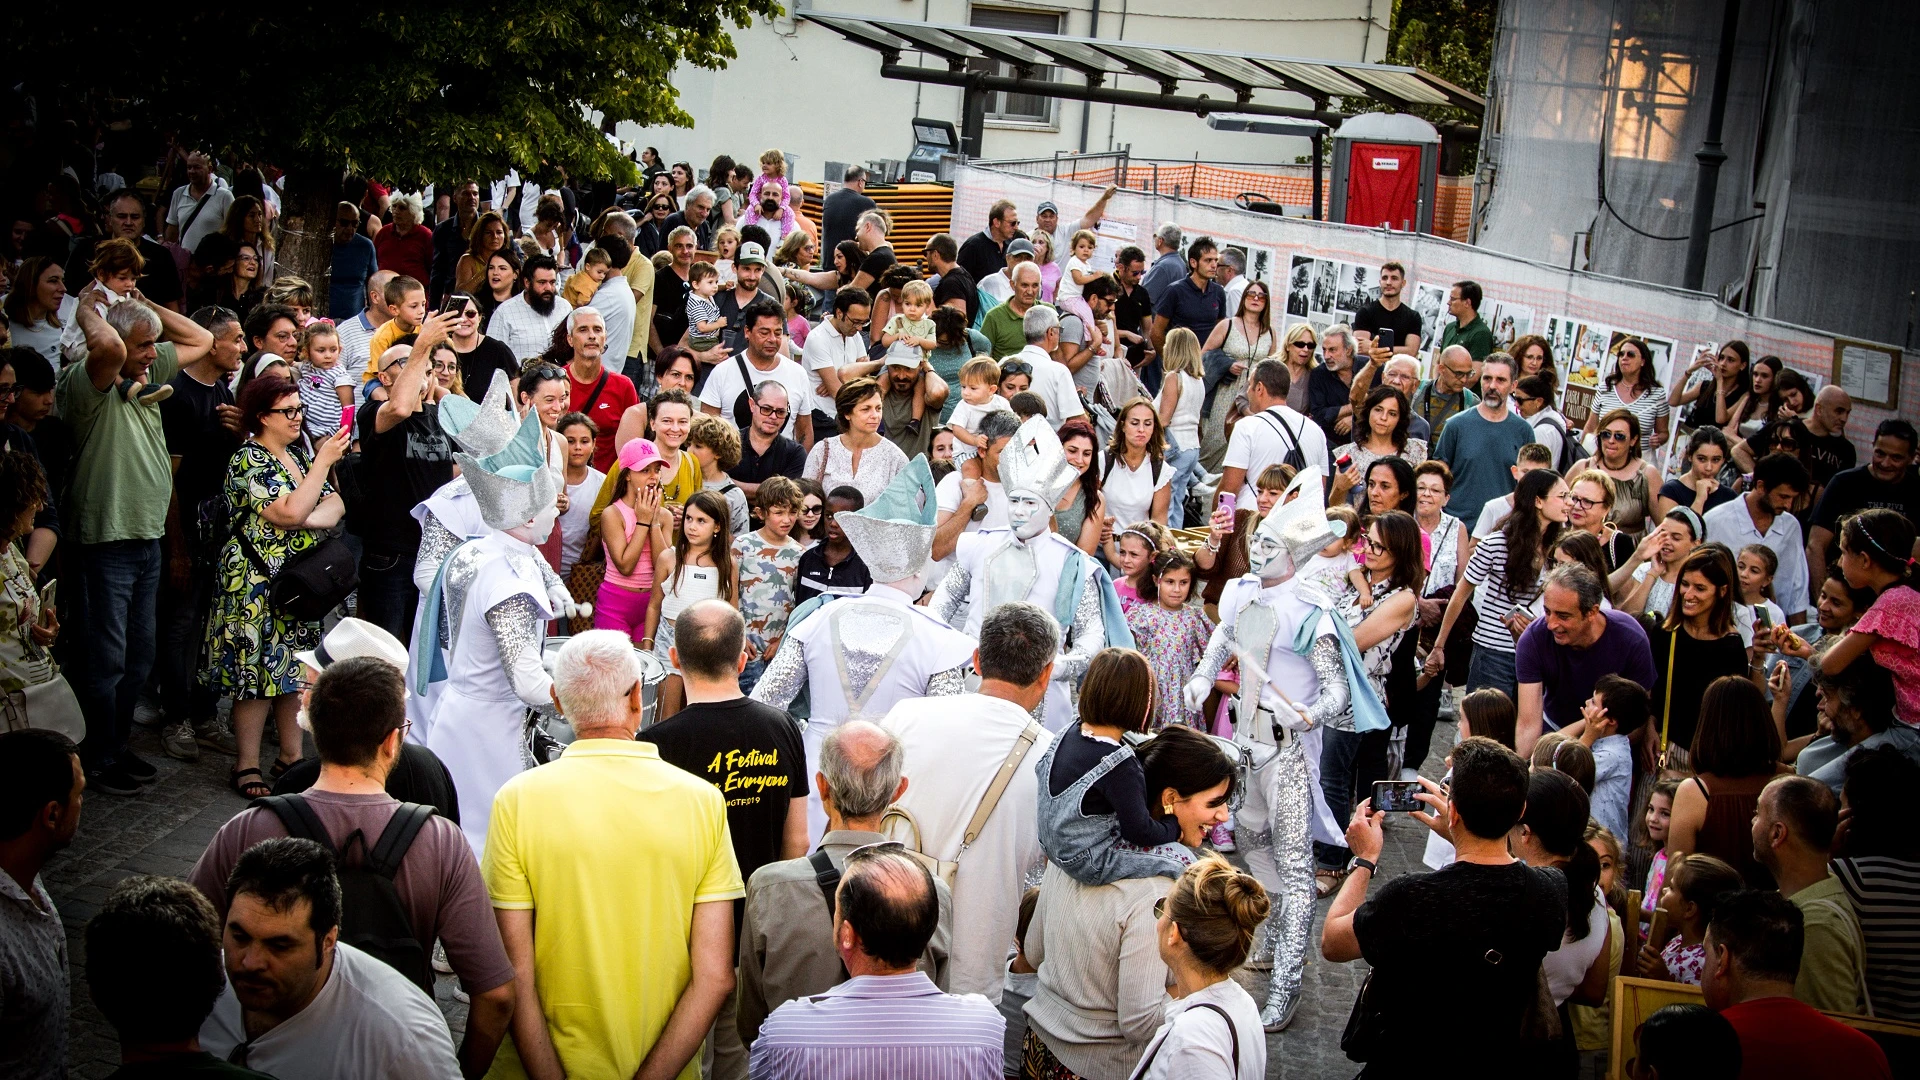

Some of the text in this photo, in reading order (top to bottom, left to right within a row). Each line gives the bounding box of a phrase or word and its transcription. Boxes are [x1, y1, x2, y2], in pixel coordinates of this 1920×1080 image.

[1867, 501, 1884, 509] THE
[707, 749, 779, 773] A Festival
[724, 771, 789, 793] Everyone
